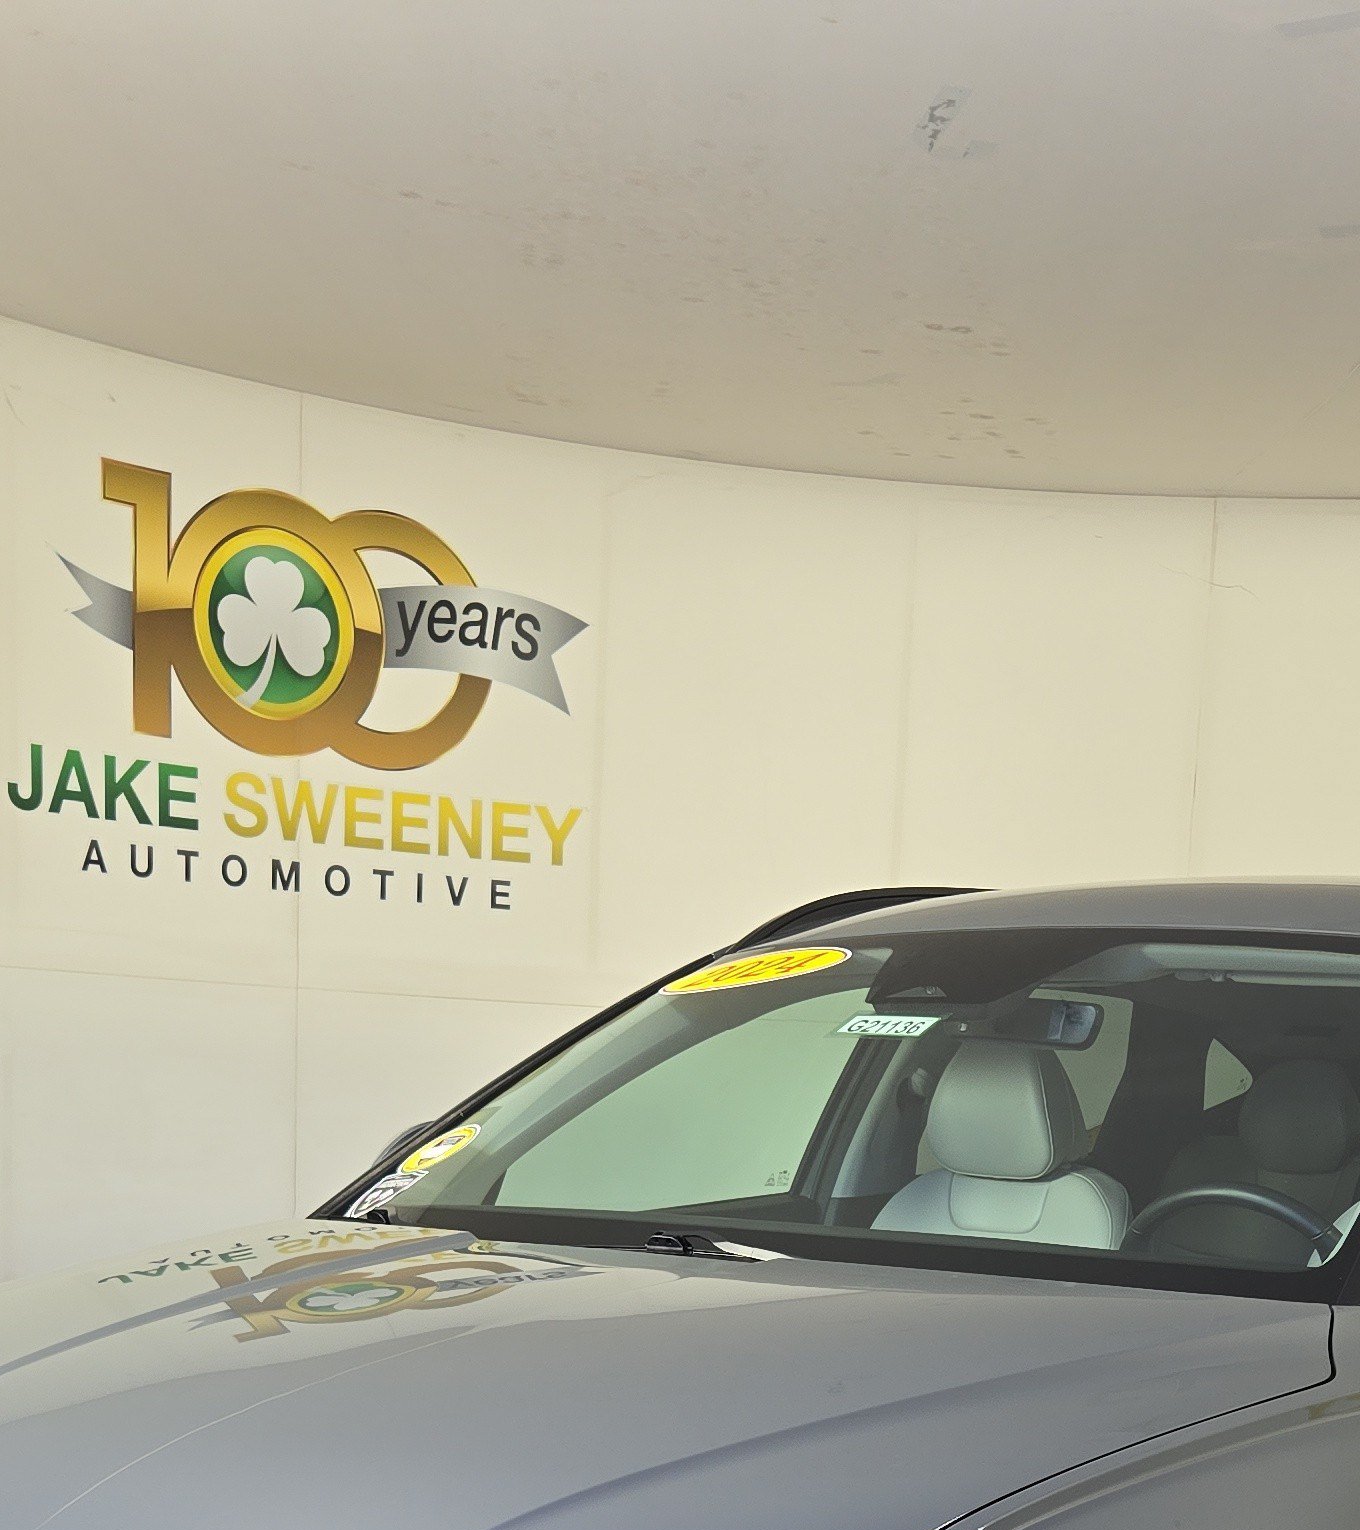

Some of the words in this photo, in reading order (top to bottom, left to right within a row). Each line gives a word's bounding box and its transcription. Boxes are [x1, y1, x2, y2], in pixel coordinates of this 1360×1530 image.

[100, 456, 493, 771] 100
[394, 599, 542, 662] years
[7, 742, 200, 832] JAKE
[223, 771, 583, 868] SWEENEY
[81, 838, 512, 911] AUTOMOTIVE
[680, 951, 829, 989] 2024
[846, 1018, 925, 1035] G21136
